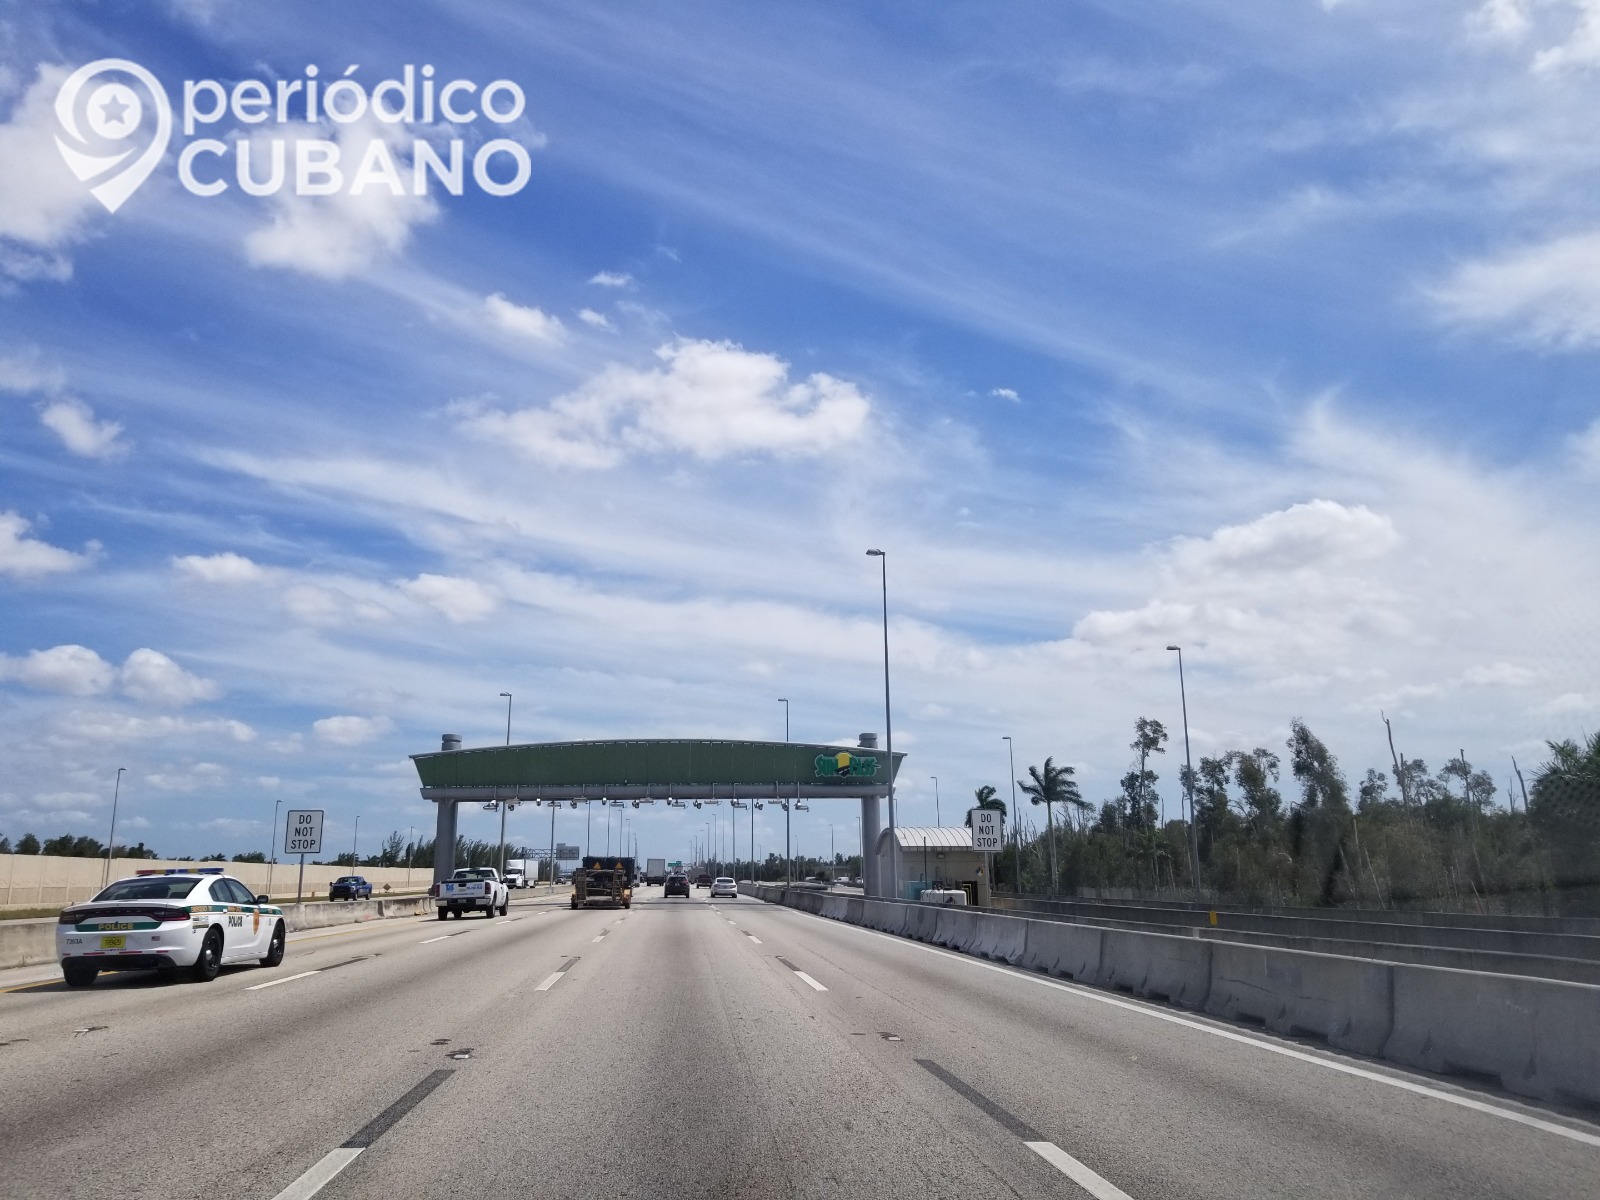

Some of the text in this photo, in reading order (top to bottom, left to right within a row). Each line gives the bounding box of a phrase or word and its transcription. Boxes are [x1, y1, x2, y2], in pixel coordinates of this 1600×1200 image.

[298, 814, 312, 825] DO
[980, 813, 992, 823] DO
[294, 826, 315, 837] NOT
[978, 825, 995, 835] NOT
[290, 839, 316, 850] STOP
[976, 837, 998, 848] STOP
[97, 922, 134, 931] POLICE
